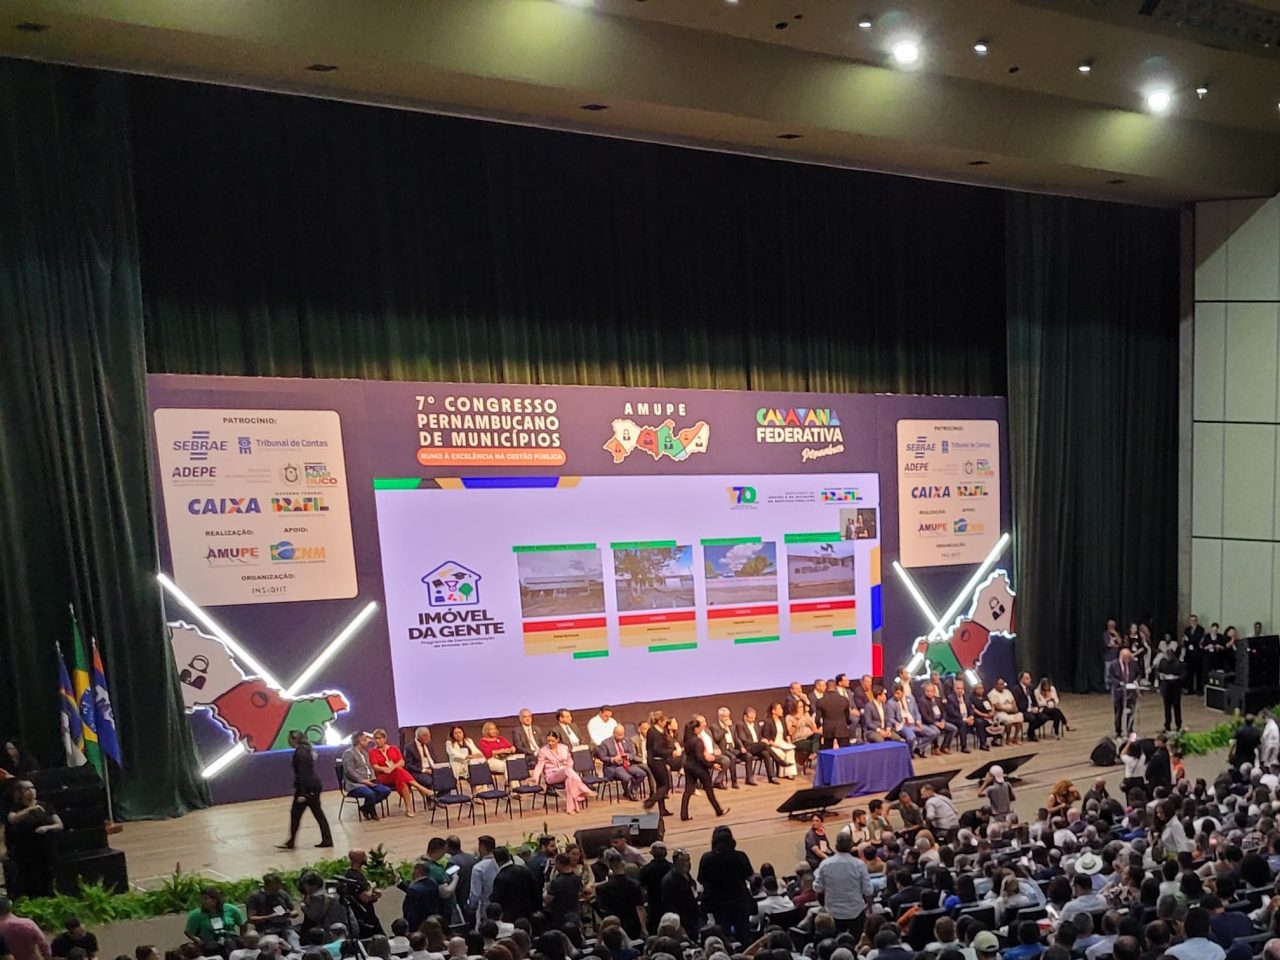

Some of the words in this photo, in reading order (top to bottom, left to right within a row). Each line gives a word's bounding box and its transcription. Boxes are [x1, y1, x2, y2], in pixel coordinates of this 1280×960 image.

[444, 397, 557, 413] CONGRESSO
[624, 402, 687, 416] AMUPE
[223, 417, 278, 425] PATROCÍNIO:
[417, 413, 560, 431] PERNAMBUCANO
[756, 408, 841, 426] CARAVANA
[419, 431, 443, 447] DE
[451, 429, 561, 448] MUNICÍPIOS
[756, 427, 843, 443] FEDERATIVA
[172, 440, 228, 451] SEBRAE
[256, 439, 289, 447] Tribunal
[290, 439, 300, 447] de
[301, 440, 328, 448] Contas
[906, 443, 936, 452] SEBRAE
[172, 466, 217, 478] ADEPE
[904, 463, 929, 471] ADEPE
[911, 486, 951, 498] CAIXA
[188, 498, 262, 515] CAIXA
[205, 529, 255, 537] REALIZAÇÃO:
[207, 547, 259, 559] AMUPE
[418, 608, 494, 625] IMÓVEL
[408, 627, 437, 640] DA
[439, 622, 505, 637] GENTE
